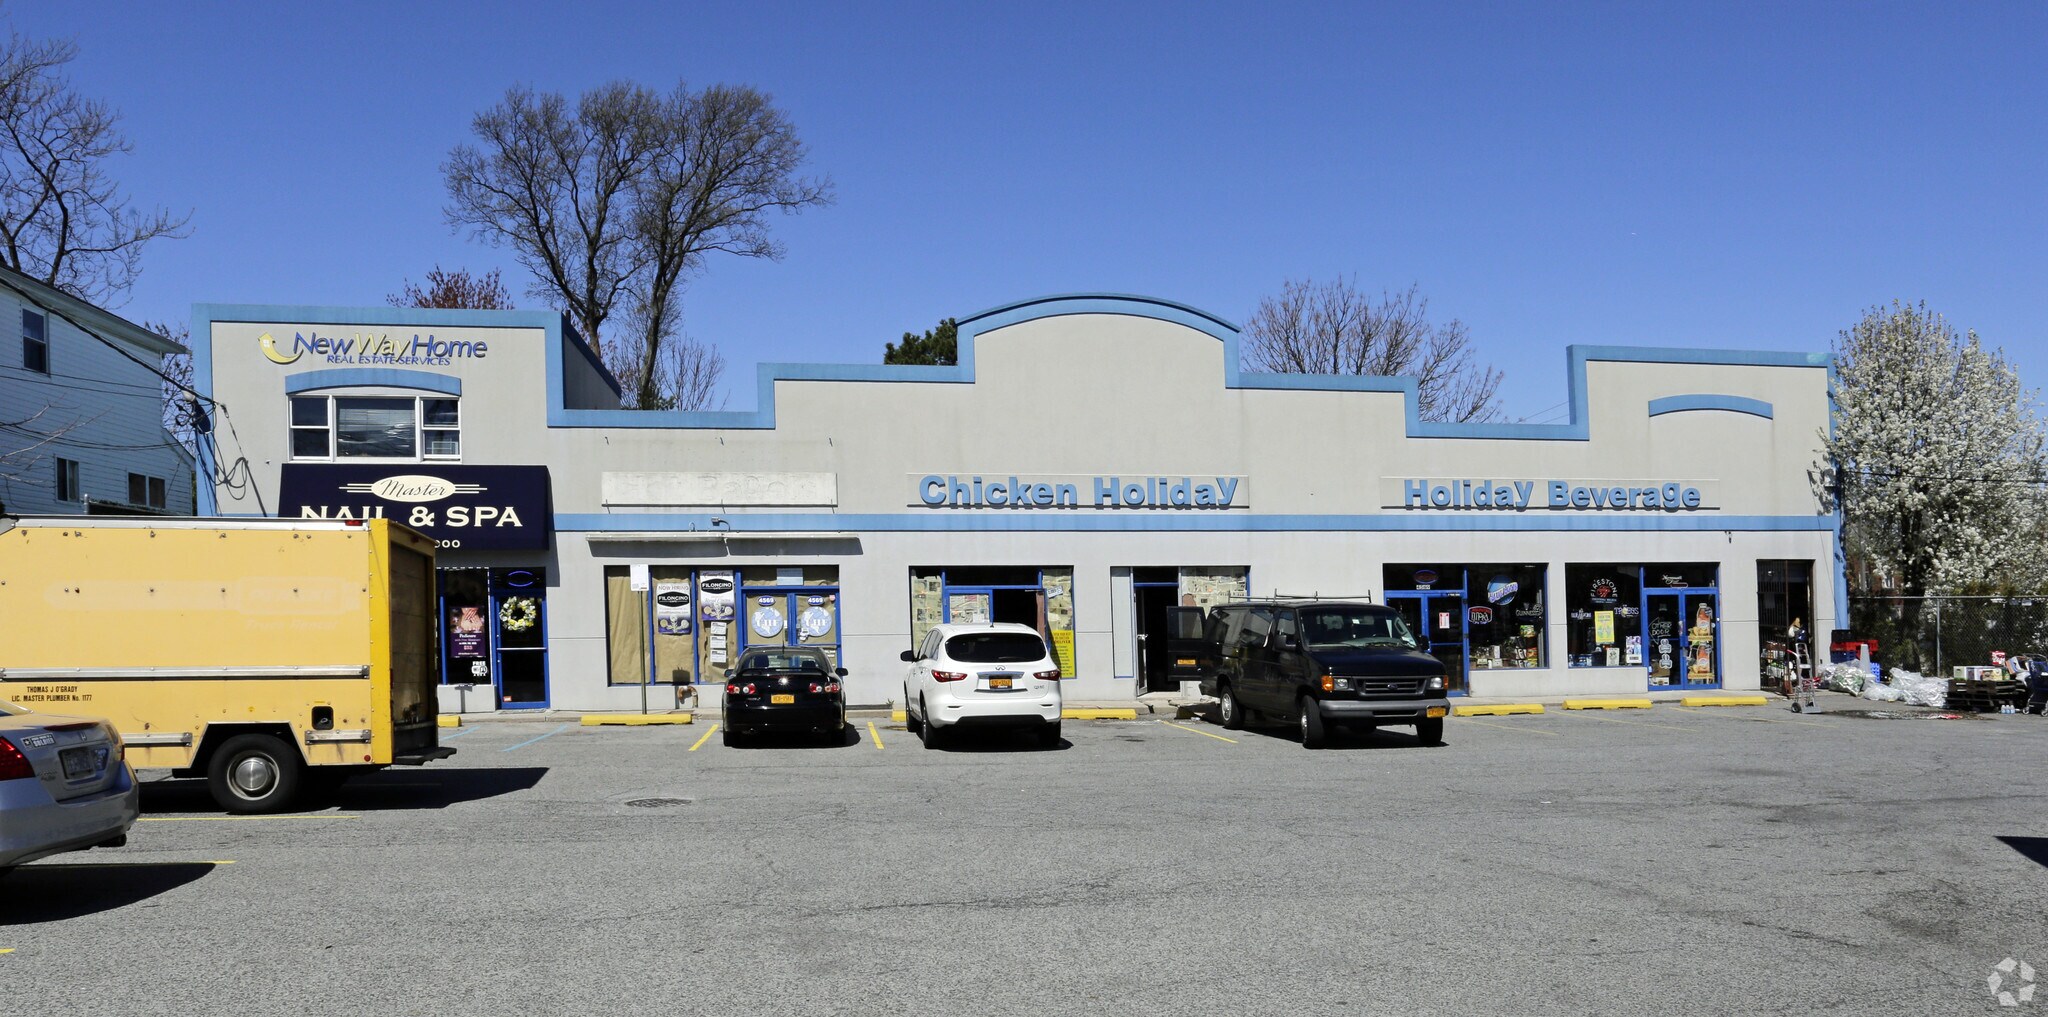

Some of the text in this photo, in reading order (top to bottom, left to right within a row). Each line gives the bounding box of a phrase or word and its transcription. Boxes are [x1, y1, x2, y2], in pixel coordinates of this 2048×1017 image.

[411, 334, 488, 358] Home
[326, 355, 452, 366] REAL ESTATE SERVICES
[379, 479, 447, 498] Master
[918, 475, 1239, 507] Chicken Holiday
[1404, 480, 1701, 510] Holiday Beverage
[408, 505, 436, 528] &
[446, 506, 524, 528] SPA
[1590, 578, 1618, 598] FIRESTONE
